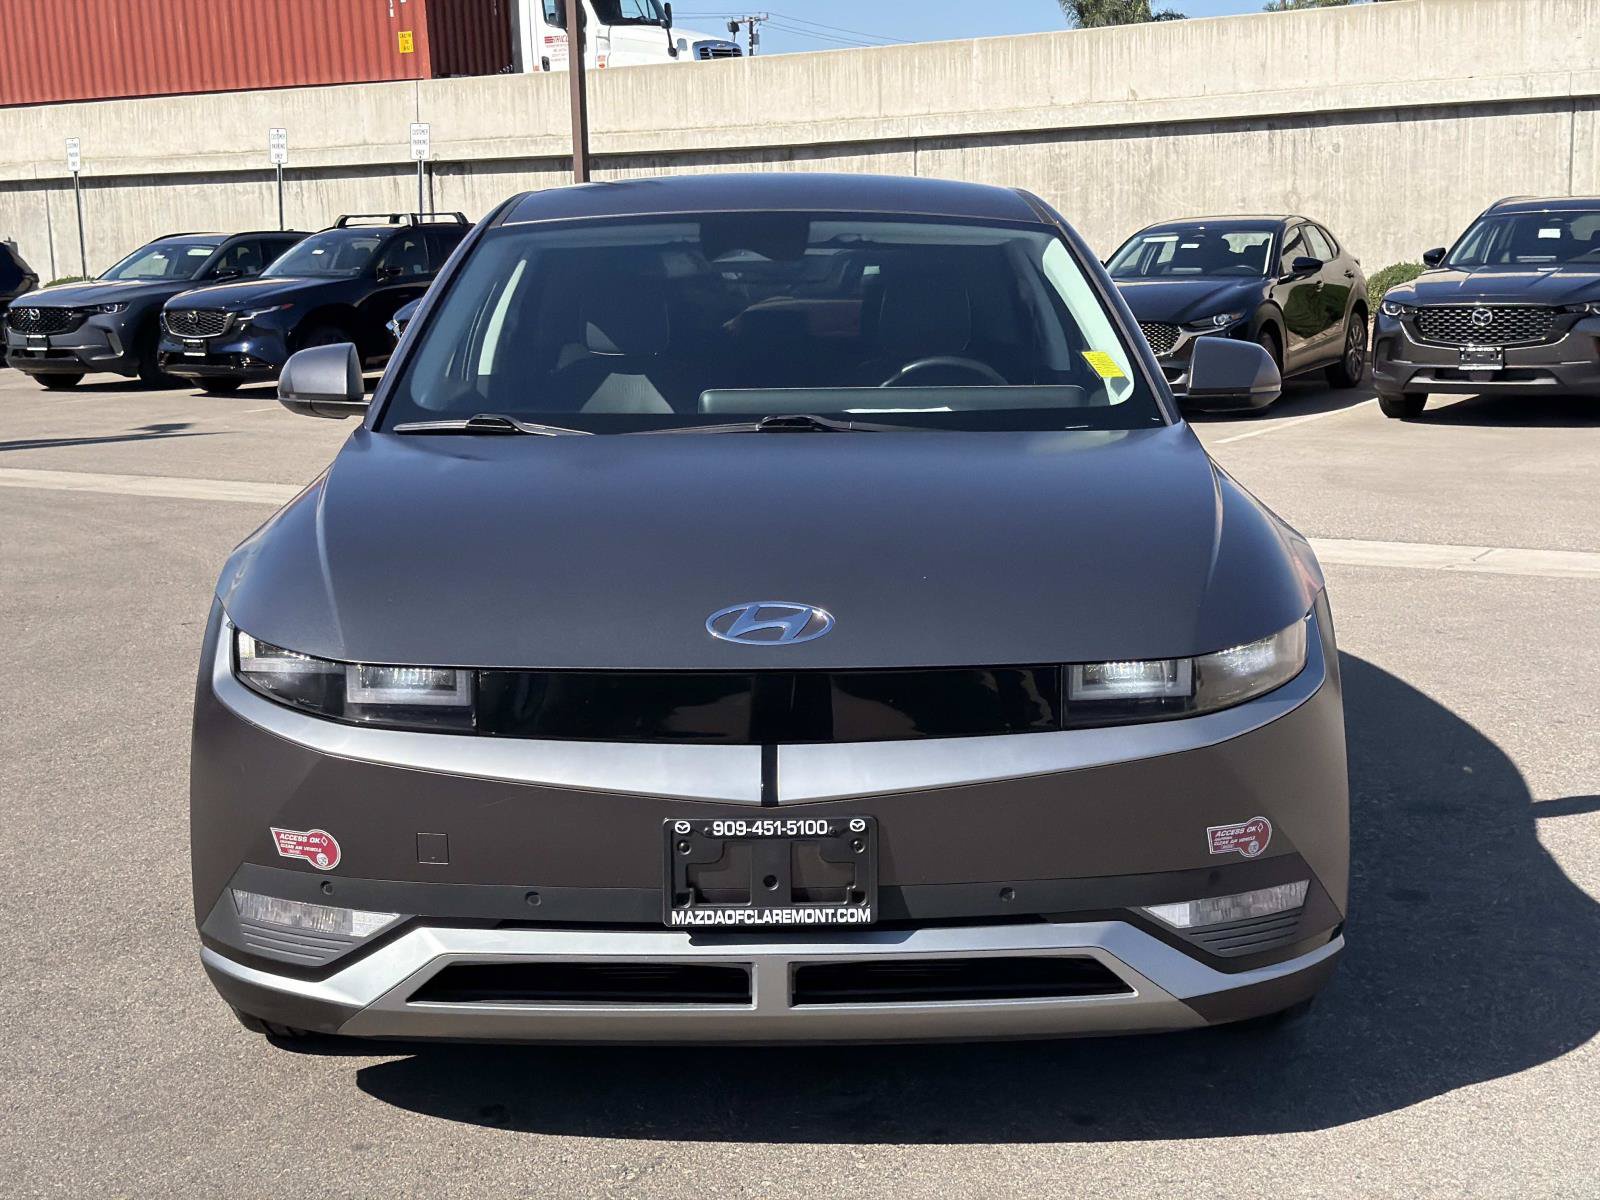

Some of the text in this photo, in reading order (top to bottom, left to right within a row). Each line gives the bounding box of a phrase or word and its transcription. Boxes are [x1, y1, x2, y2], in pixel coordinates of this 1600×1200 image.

[713, 820, 828, 836] 909-451-5100
[1215, 828, 1245, 838] ACCESS
[280, 833, 308, 842] ACCESS
[671, 909, 871, 925] MAZDAOFCLAREMONT.COM
